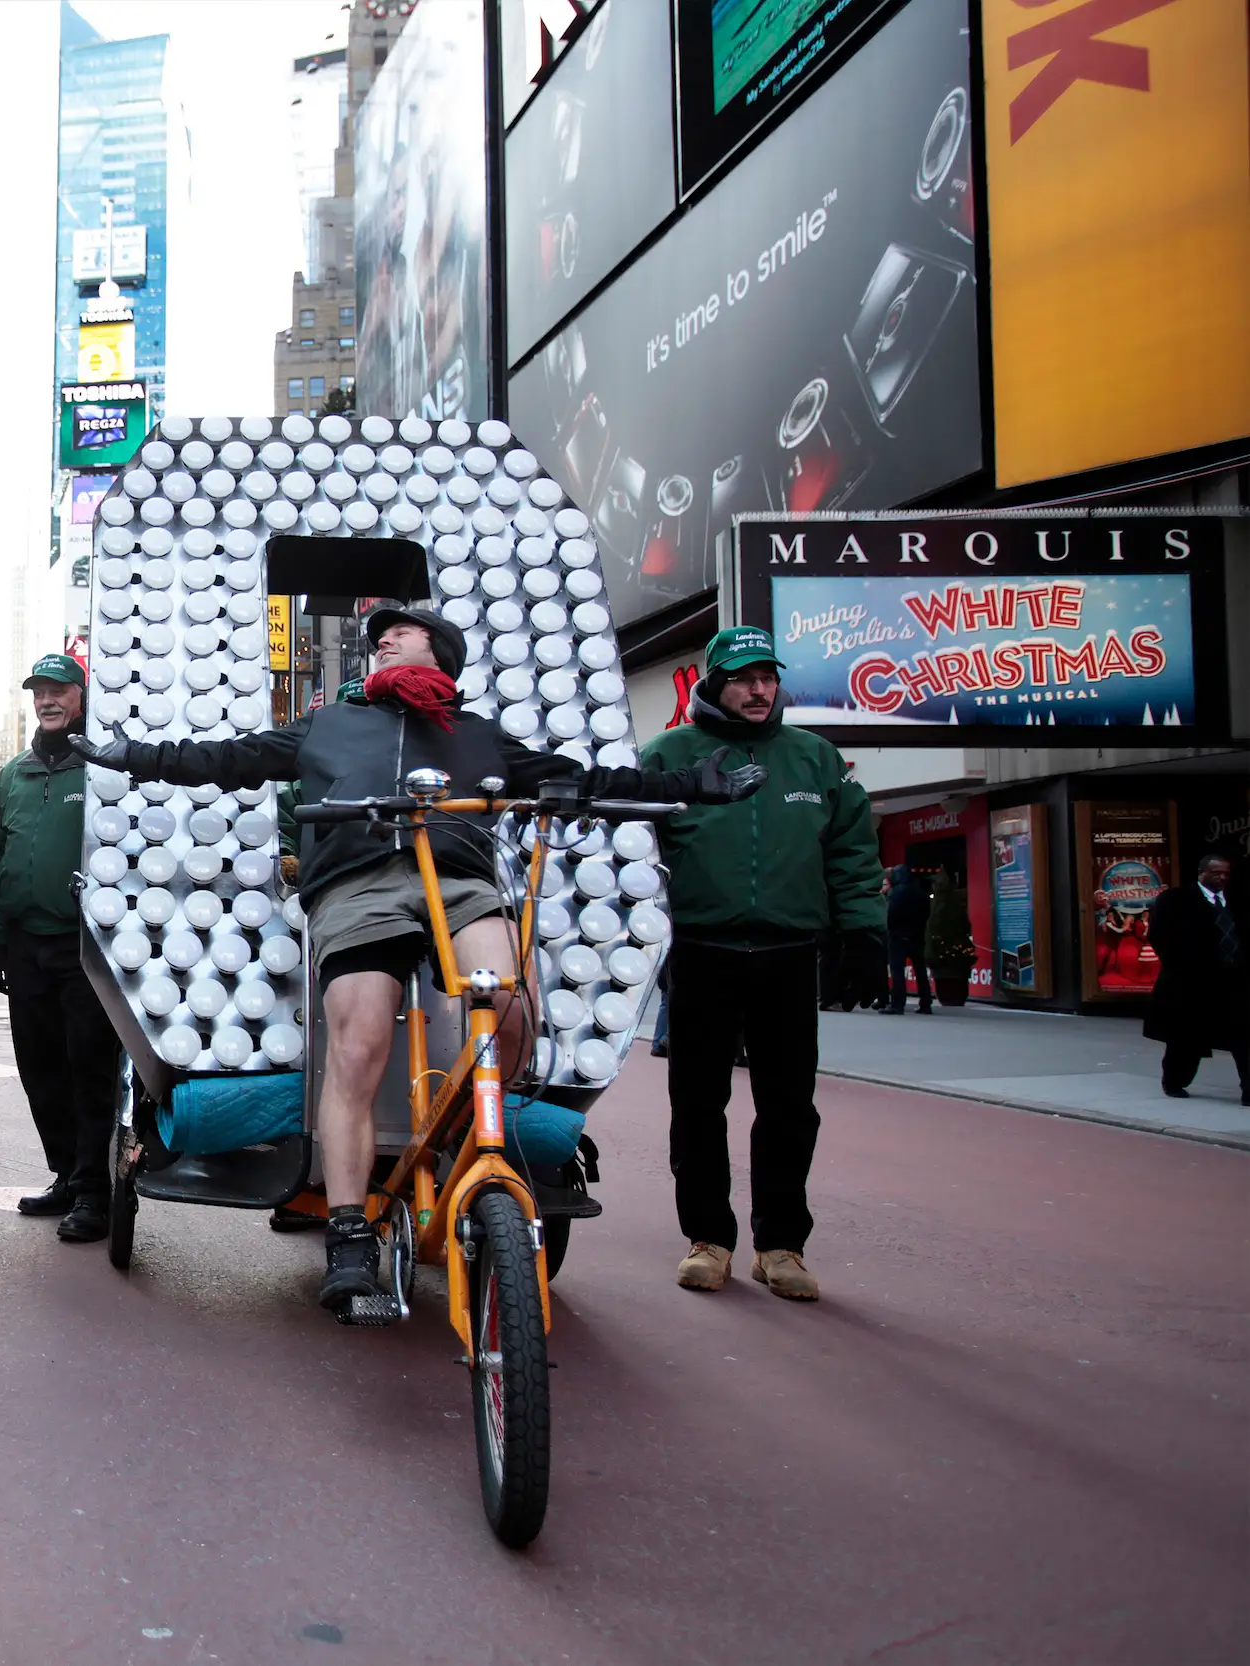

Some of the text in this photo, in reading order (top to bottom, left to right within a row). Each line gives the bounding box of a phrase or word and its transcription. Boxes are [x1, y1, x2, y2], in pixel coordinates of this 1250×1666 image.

[1007, 0, 1177, 147] K
[646, 333, 670, 374] it's
[675, 293, 720, 349] time
[726, 269, 750, 306] to
[62, 383, 145, 402] TOSHIBA
[79, 418, 124, 431] REGZA
[769, 529, 1191, 565] MARQUIS
[784, 602, 868, 643] Irving
[901, 580, 1086, 641] WHITE
[820, 617, 916, 660] Berlin's
[848, 624, 1167, 716] CHRISTMAS
[974, 688, 1099, 707] THE MUSICAL
